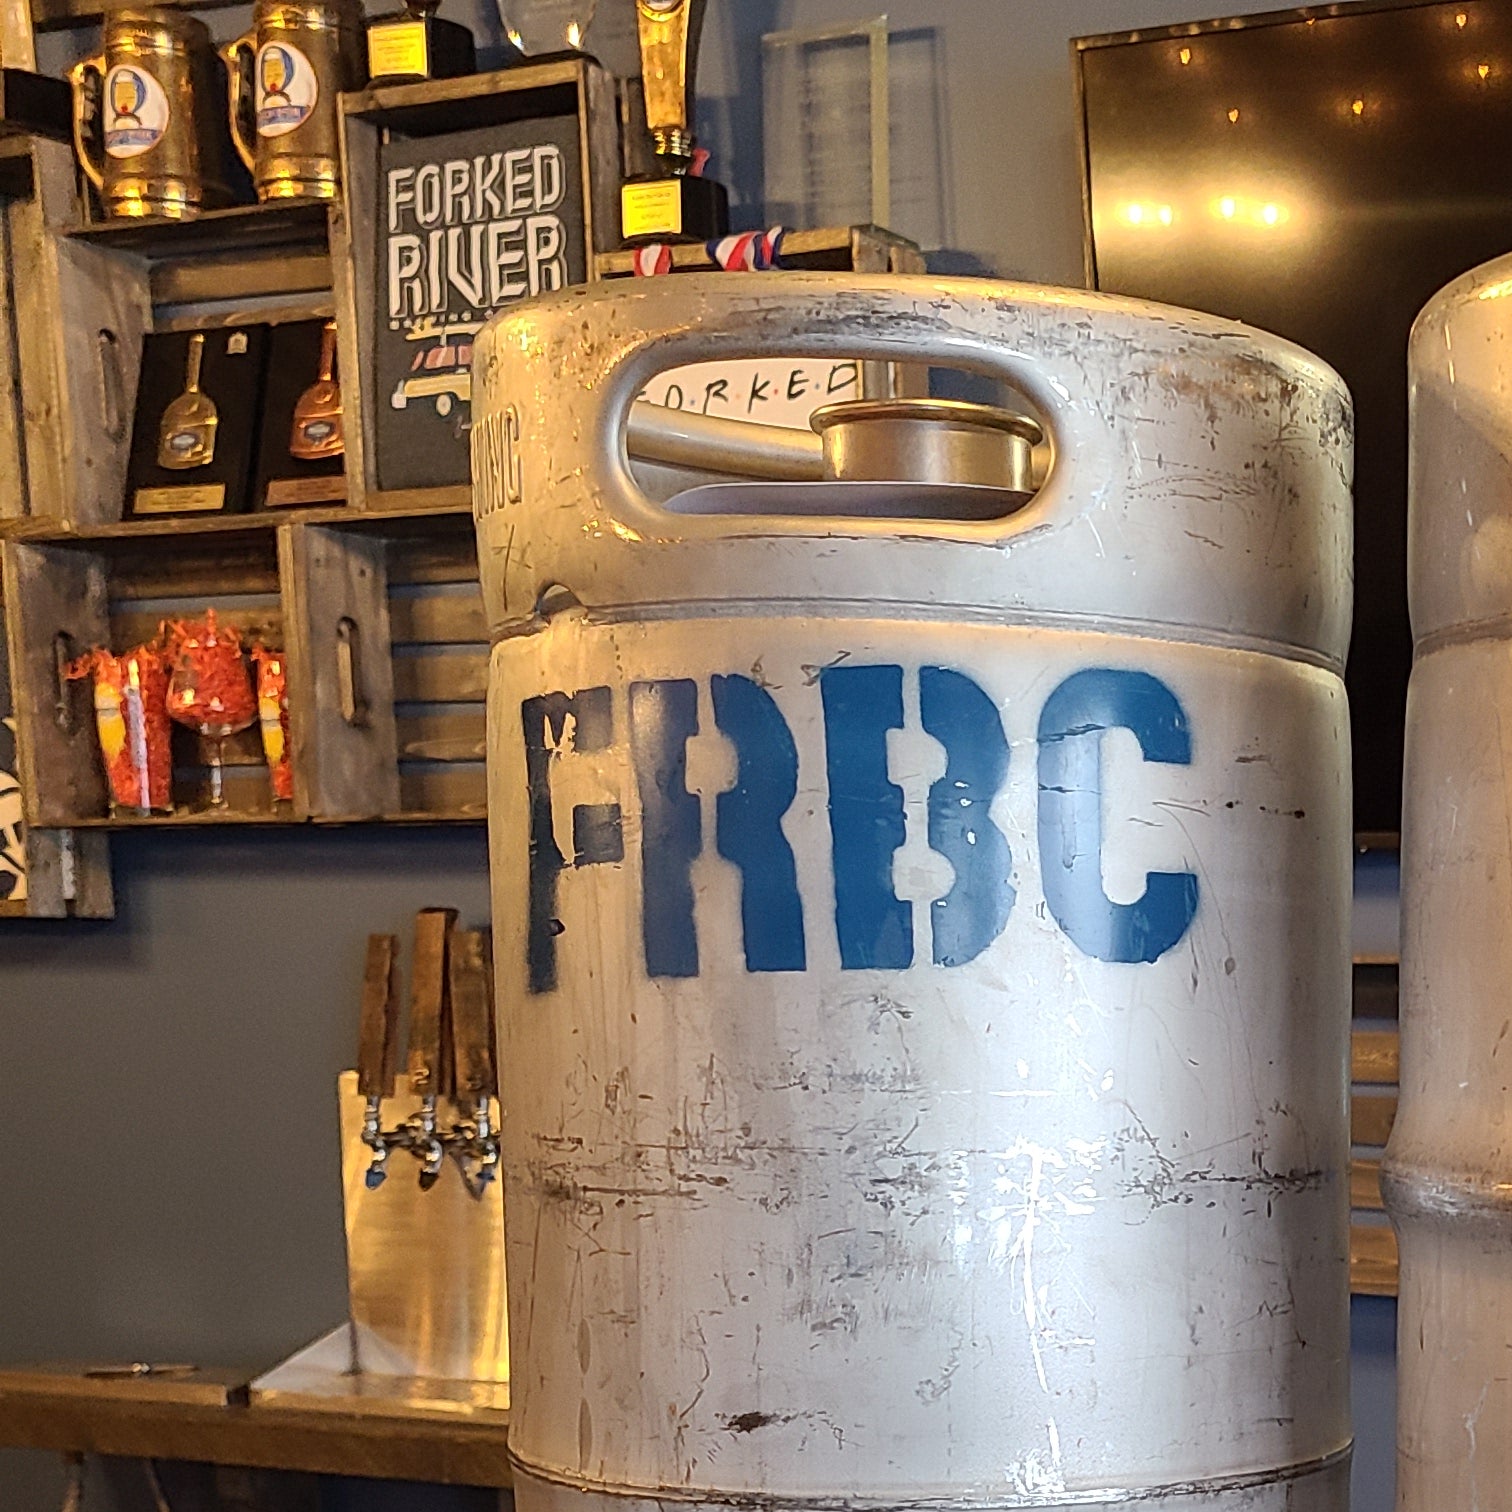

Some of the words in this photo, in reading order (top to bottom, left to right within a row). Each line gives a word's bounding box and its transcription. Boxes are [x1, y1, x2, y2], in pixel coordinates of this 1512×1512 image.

[388, 144, 566, 234] FORKED
[388, 214, 569, 318] RIVER
[635, 362, 858, 415] ORKED
[521, 664, 1198, 994] FRBC
